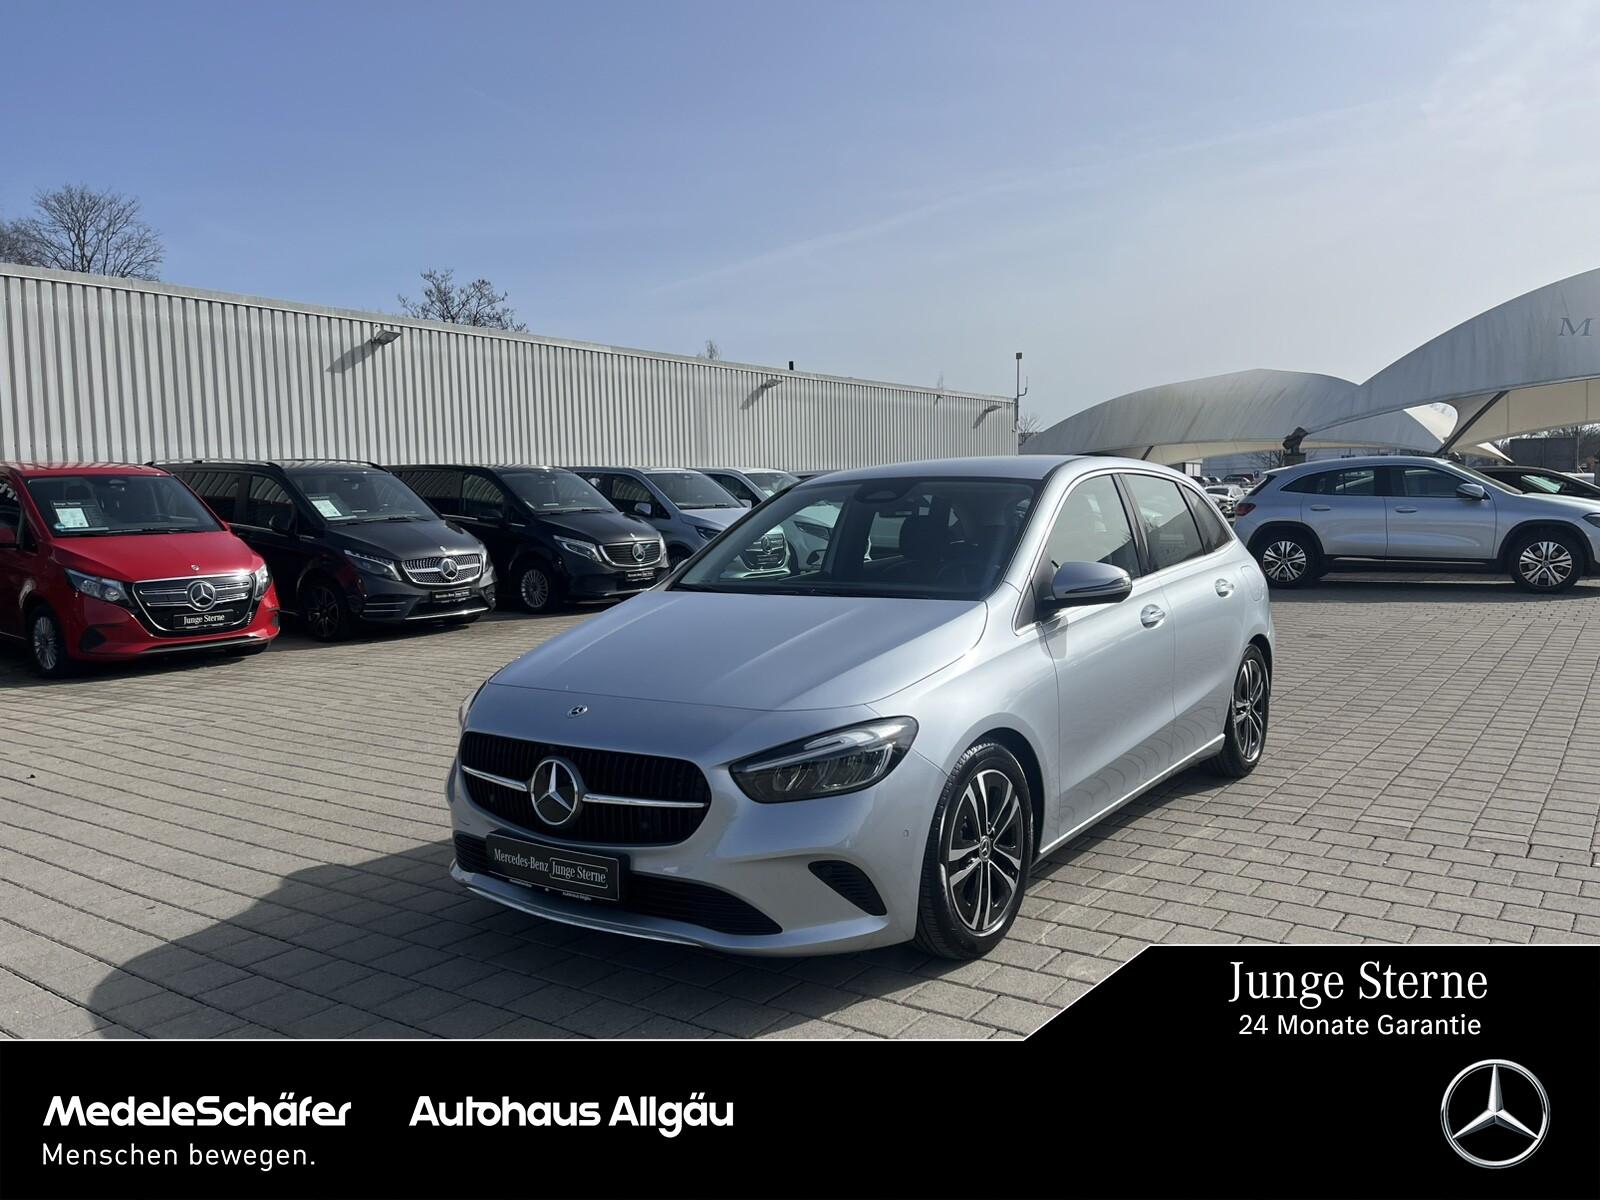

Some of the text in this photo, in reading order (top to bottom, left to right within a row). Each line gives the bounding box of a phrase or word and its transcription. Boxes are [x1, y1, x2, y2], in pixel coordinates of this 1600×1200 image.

[183, 614, 225, 625] Junge Sterne
[494, 847, 606, 884] Mercedes-Benz Junge Sterne
